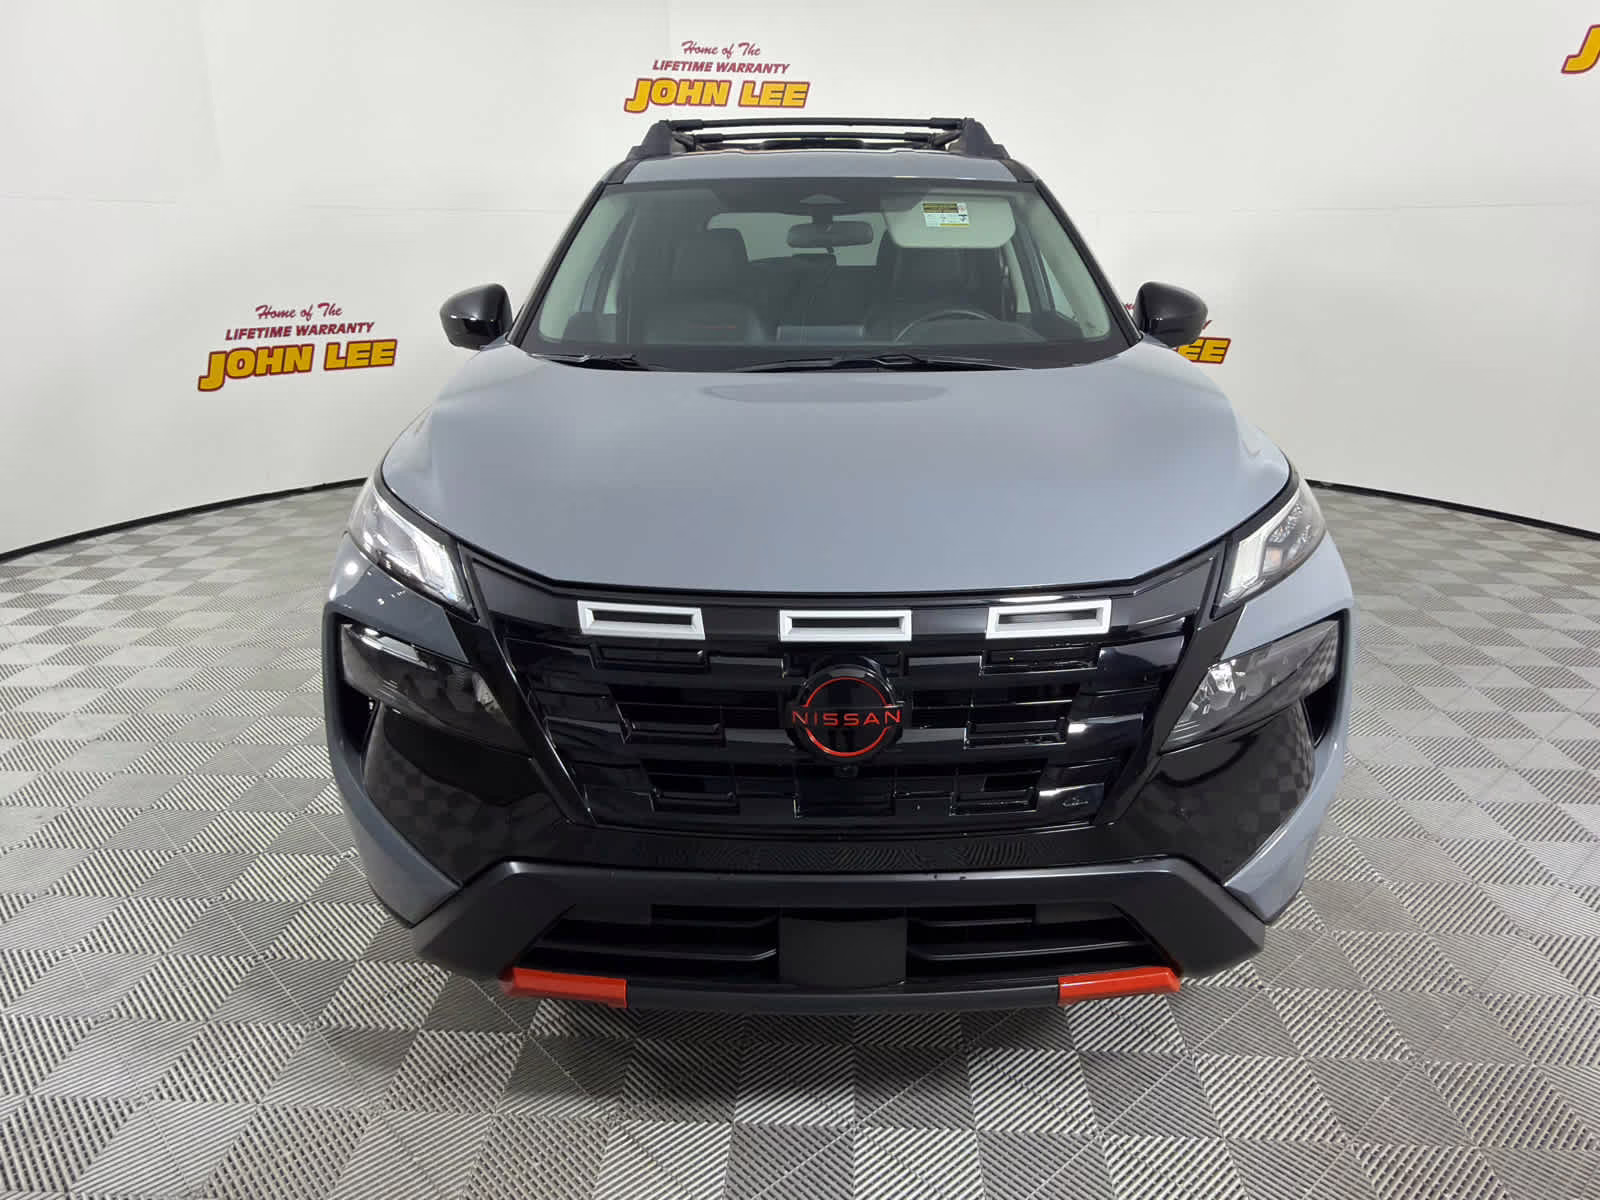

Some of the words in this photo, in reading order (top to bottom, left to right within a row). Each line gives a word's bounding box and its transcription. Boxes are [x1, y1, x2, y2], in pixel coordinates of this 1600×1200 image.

[681, 40, 718, 55] Home
[721, 43, 734, 59] of
[738, 42, 761, 56] The
[652, 60, 713, 72] LIFETIME
[716, 62, 790, 74] WARRANTY
[624, 77, 732, 114] JOHN
[738, 80, 810, 108] LEE
[256, 304, 296, 319] Home
[300, 304, 313, 321] of
[318, 303, 343, 317] The
[225, 326, 292, 341] LIFETIME
[296, 322, 375, 337] WARRANTY
[1172, 336, 1231, 364] EE
[198, 343, 315, 392] JOHN
[324, 339, 397, 371] LEE
[791, 709, 902, 727] NISSAN
